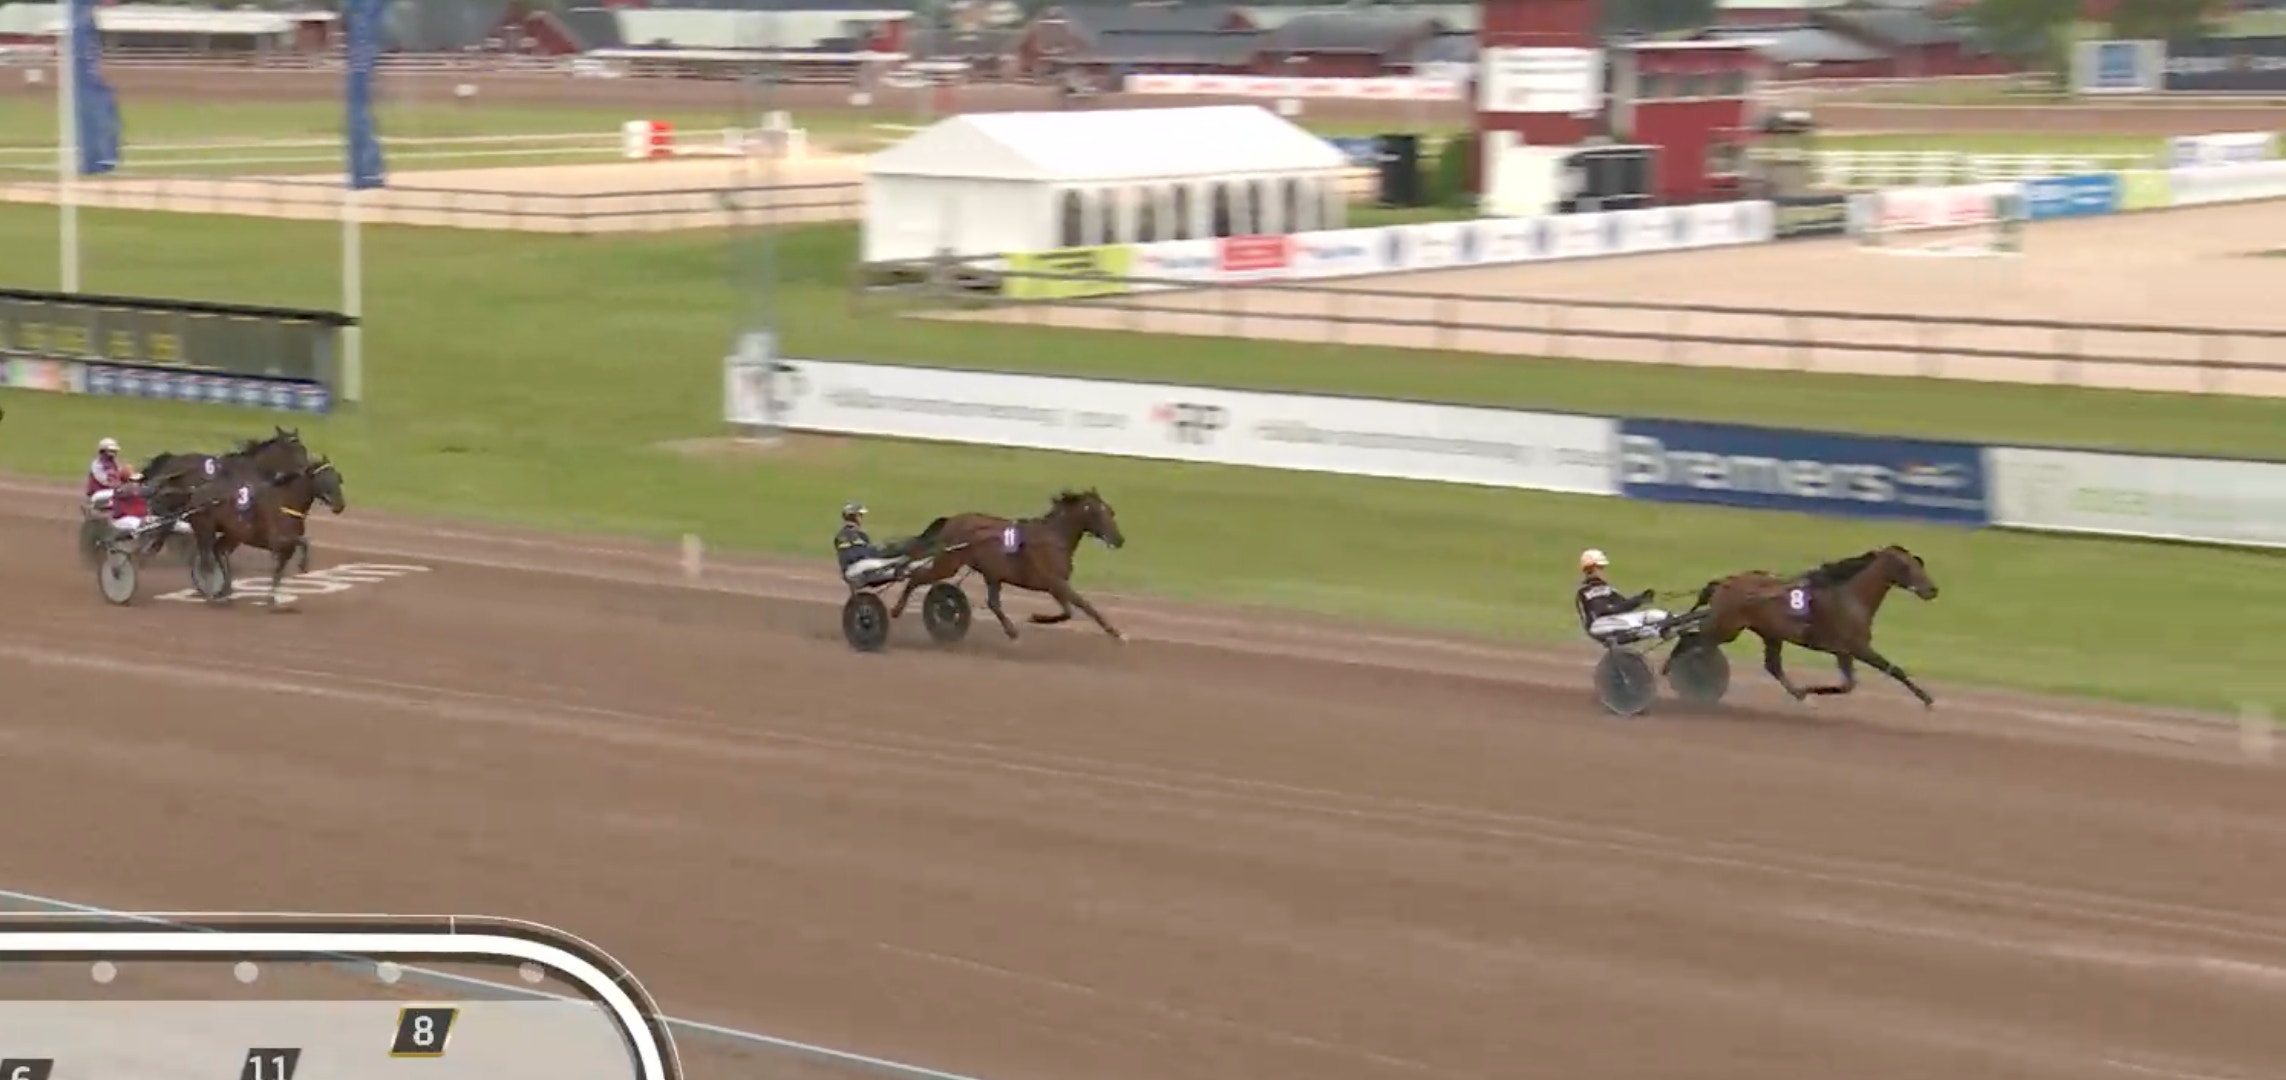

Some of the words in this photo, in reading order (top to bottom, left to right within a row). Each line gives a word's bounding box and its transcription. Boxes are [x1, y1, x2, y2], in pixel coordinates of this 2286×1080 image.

[204, 457, 215, 475] 6
[1618, 433, 1898, 503] Bremers
[237, 486, 250, 505] 3
[1003, 527, 1016, 547] 11
[1790, 589, 1804, 610] 8
